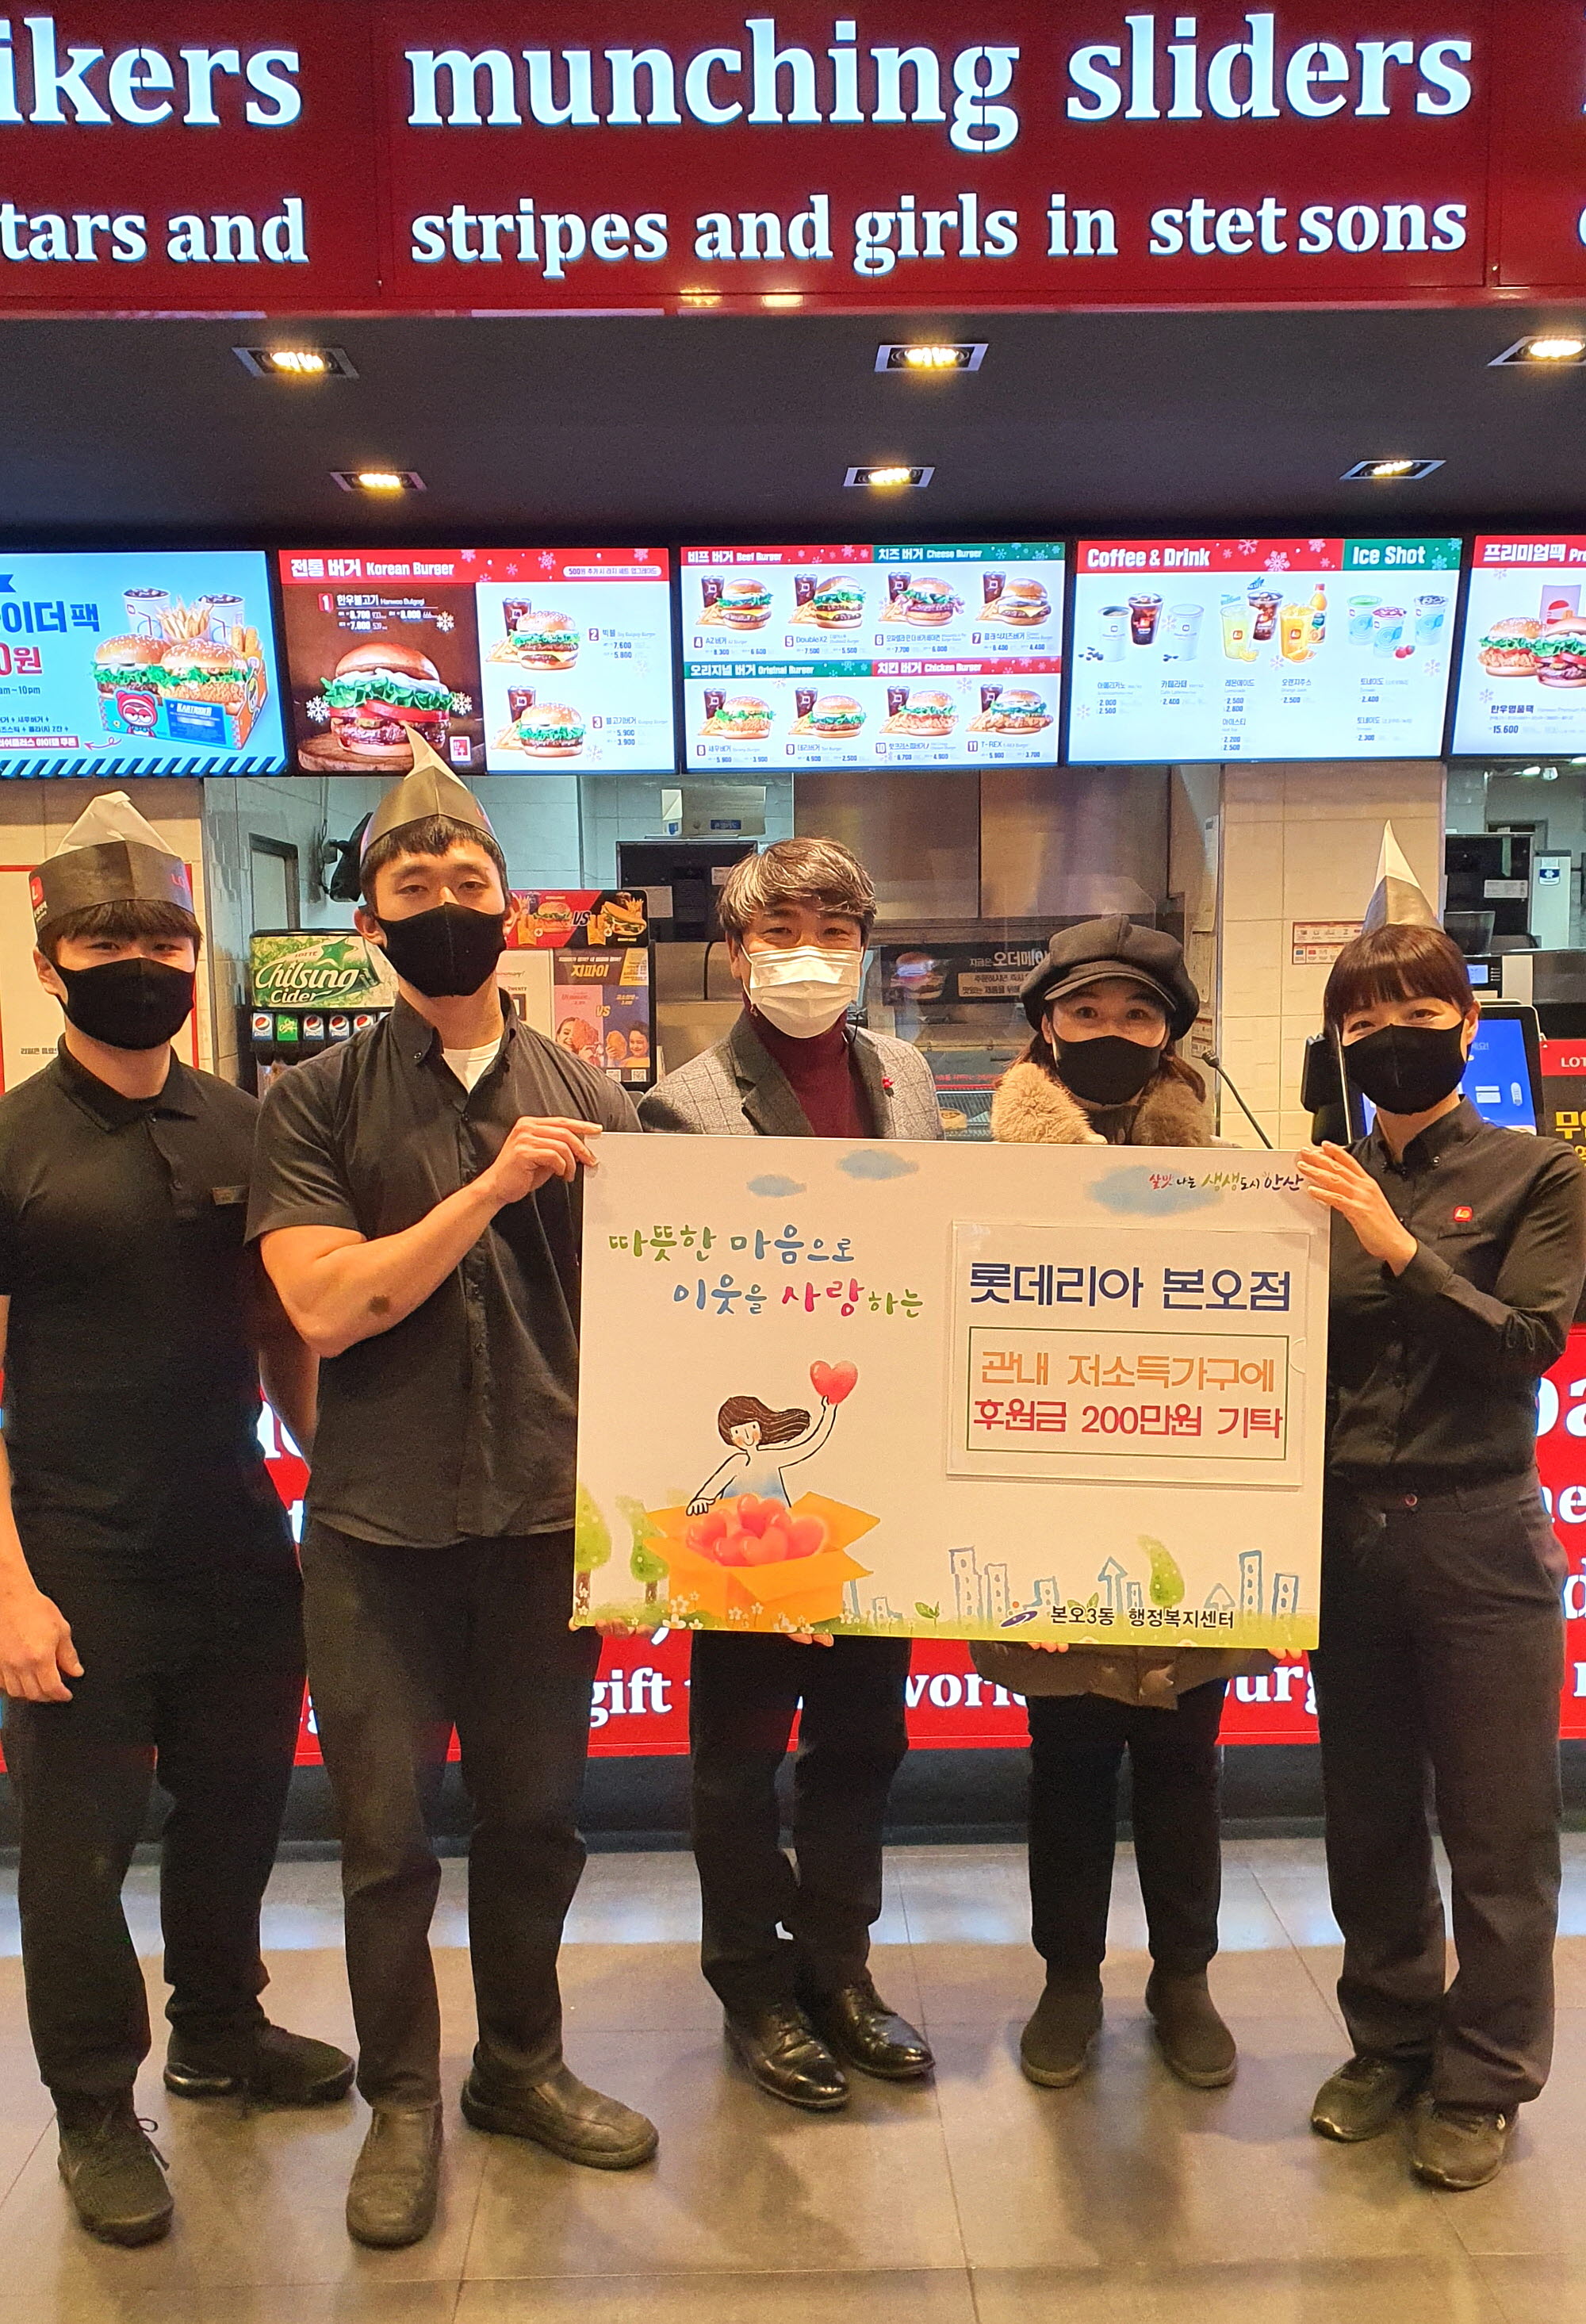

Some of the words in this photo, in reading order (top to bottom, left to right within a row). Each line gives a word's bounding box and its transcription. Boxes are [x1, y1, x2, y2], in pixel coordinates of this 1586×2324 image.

[404, 18, 1021, 152] munching
[1067, 12, 1473, 120] sliders
[166, 198, 309, 263] and
[410, 198, 670, 279] stripes
[694, 194, 833, 259] and
[852, 193, 1019, 276] girls
[1047, 194, 1118, 258] in
[688, 550, 710, 563] 비프
[711, 550, 734, 563] 버거
[878, 547, 900, 560] 치즈
[902, 547, 924, 560] 버거
[1087, 548, 1147, 568] Coffee
[1149, 550, 1161, 566] &
[1163, 547, 1211, 567] Drink
[1352, 546, 1380, 565] Ice
[1385, 545, 1427, 565] Shot
[1483, 543, 1566, 562] 프리미엄팩
[290, 558, 324, 577] 전통
[328, 558, 362, 577] 버거
[366, 562, 409, 576] Korean
[412, 562, 454, 577] Burger
[70, 604, 100, 632] 팩
[690, 664, 733, 677] 오리지널
[735, 664, 757, 676] 버거
[877, 662, 899, 674] 치킨
[900, 662, 922, 673] 버거
[877, 744, 886, 754] 10
[969, 742, 978, 751] 11
[573, 911, 592, 926] VS
[255, 960, 359, 998] Chilsung
[571, 964, 609, 977] 지파이
[270, 988, 332, 1003] Cider
[596, 1005, 611, 1018] VS
[608, 1224, 717, 1262] 따뜻한
[730, 1224, 855, 1264] 마음으로
[673, 1274, 768, 1315] 이웃을
[781, 1277, 924, 1317] 사랑하는
[970, 1262, 1144, 1309] 롯데리아
[1163, 1266, 1291, 1312] 본오점
[981, 1351, 1049, 1386] 관내
[1067, 1353, 1275, 1393] 저소득가구에
[973, 1398, 1067, 1432] 후원금
[1082, 1402, 1202, 1437] 200만원
[1217, 1406, 1284, 1440] 기탁
[1051, 1605, 1116, 1627] 본오3동
[1128, 1606, 1235, 1630] 행정복지센터
